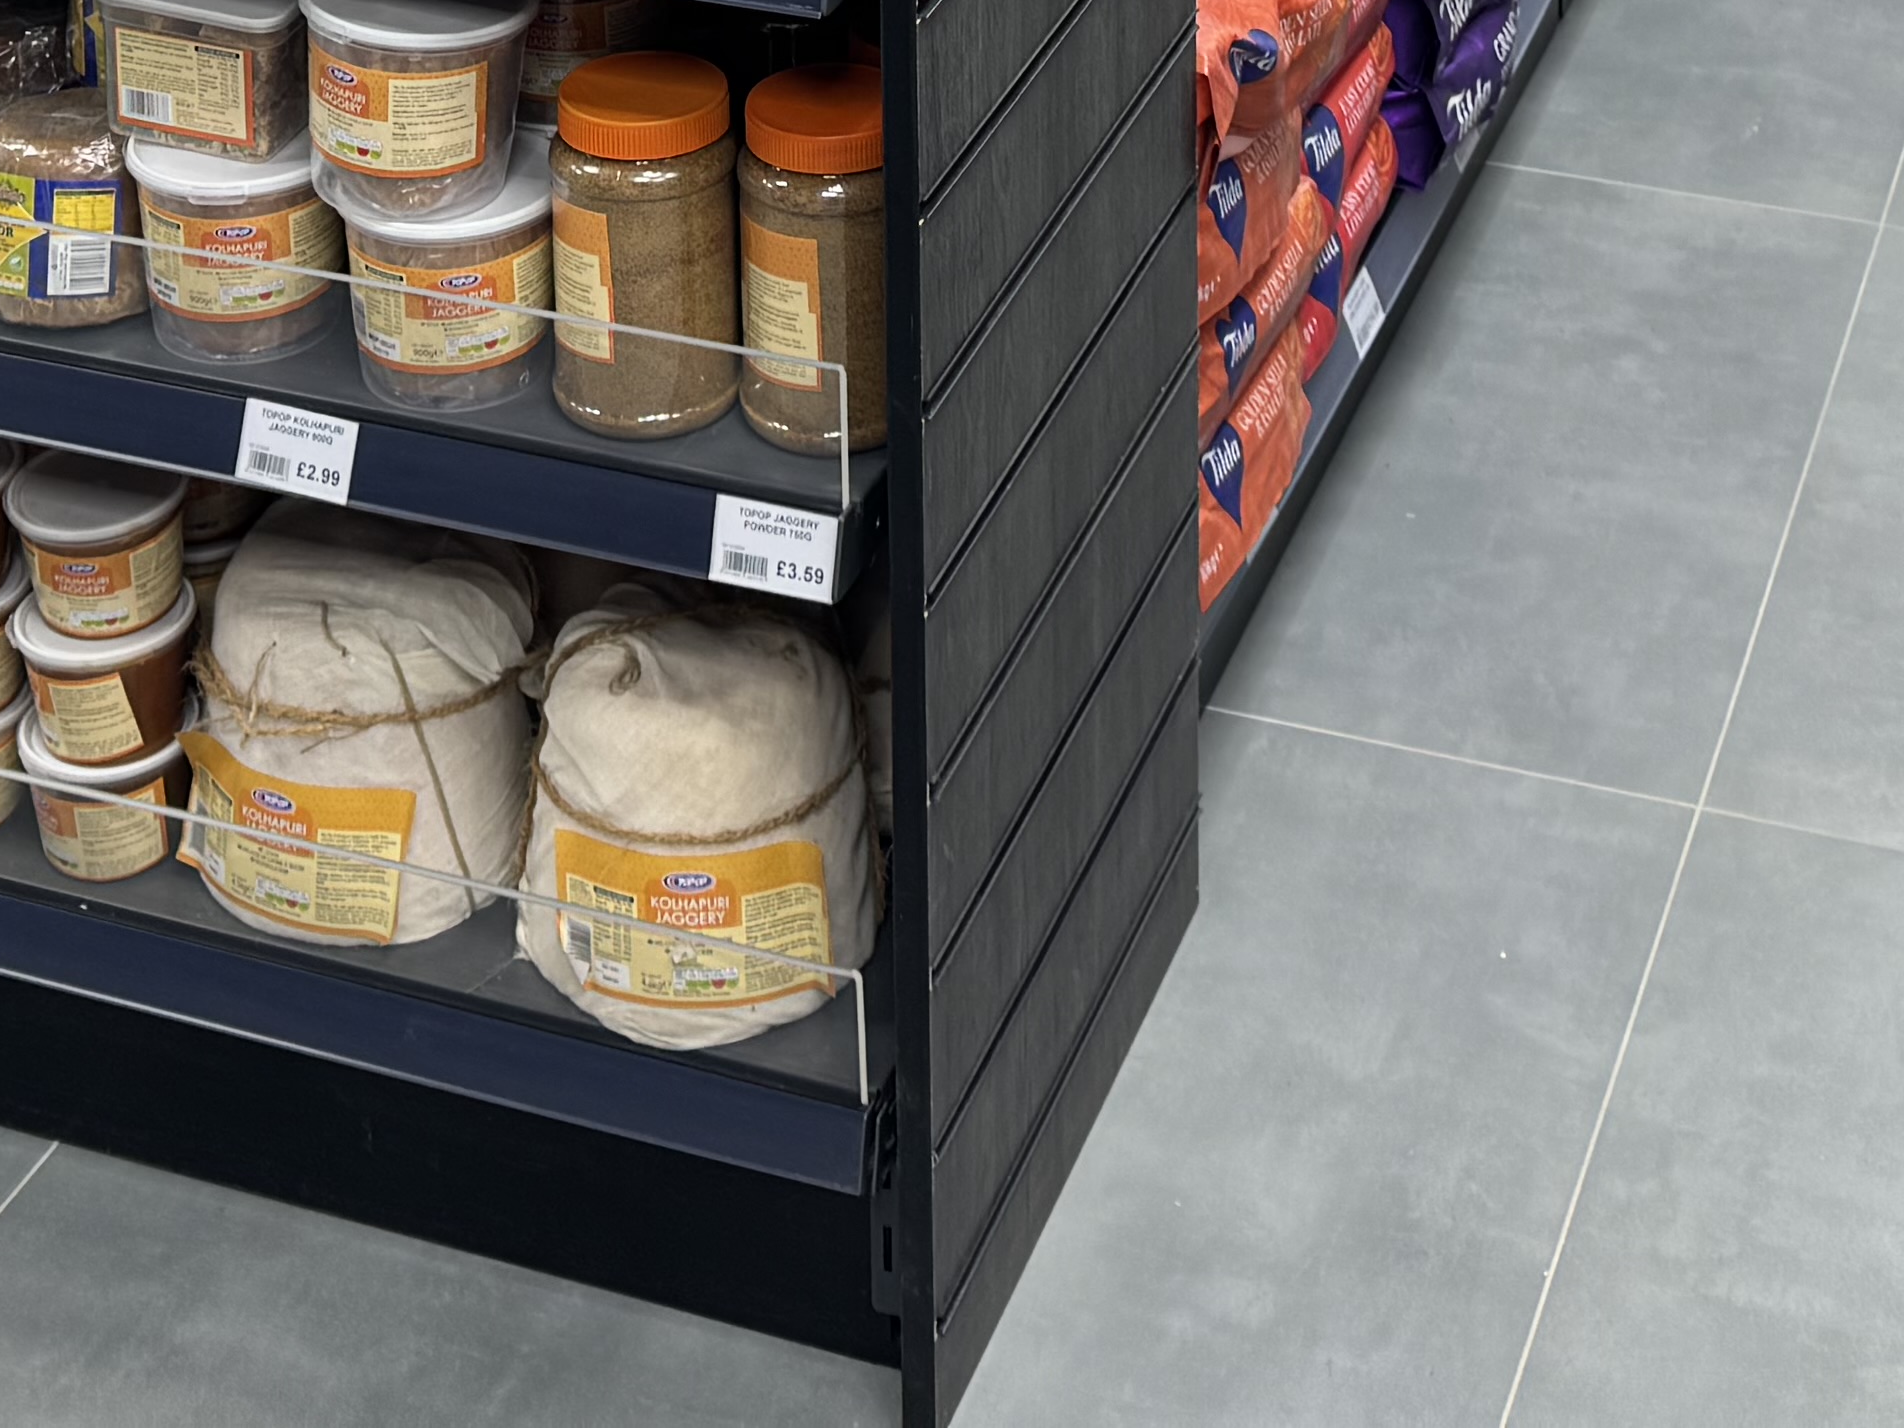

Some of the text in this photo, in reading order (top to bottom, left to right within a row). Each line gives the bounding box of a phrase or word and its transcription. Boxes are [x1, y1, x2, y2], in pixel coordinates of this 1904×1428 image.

[1447, 79, 1491, 137] Tilda
[1305, 128, 1341, 171] Tilda
[1209, 178, 1243, 219] Tilda
[1223, 321, 1254, 368] Tilda
[296, 463, 341, 486] £2.99
[1202, 437, 1240, 488] Tilda
[776, 561, 824, 586] £3.59
[242, 807, 307, 838] KOLHAPURI
[649, 895, 729, 915] KOLHAPURI
[655, 909, 726, 928] JAGGERY
